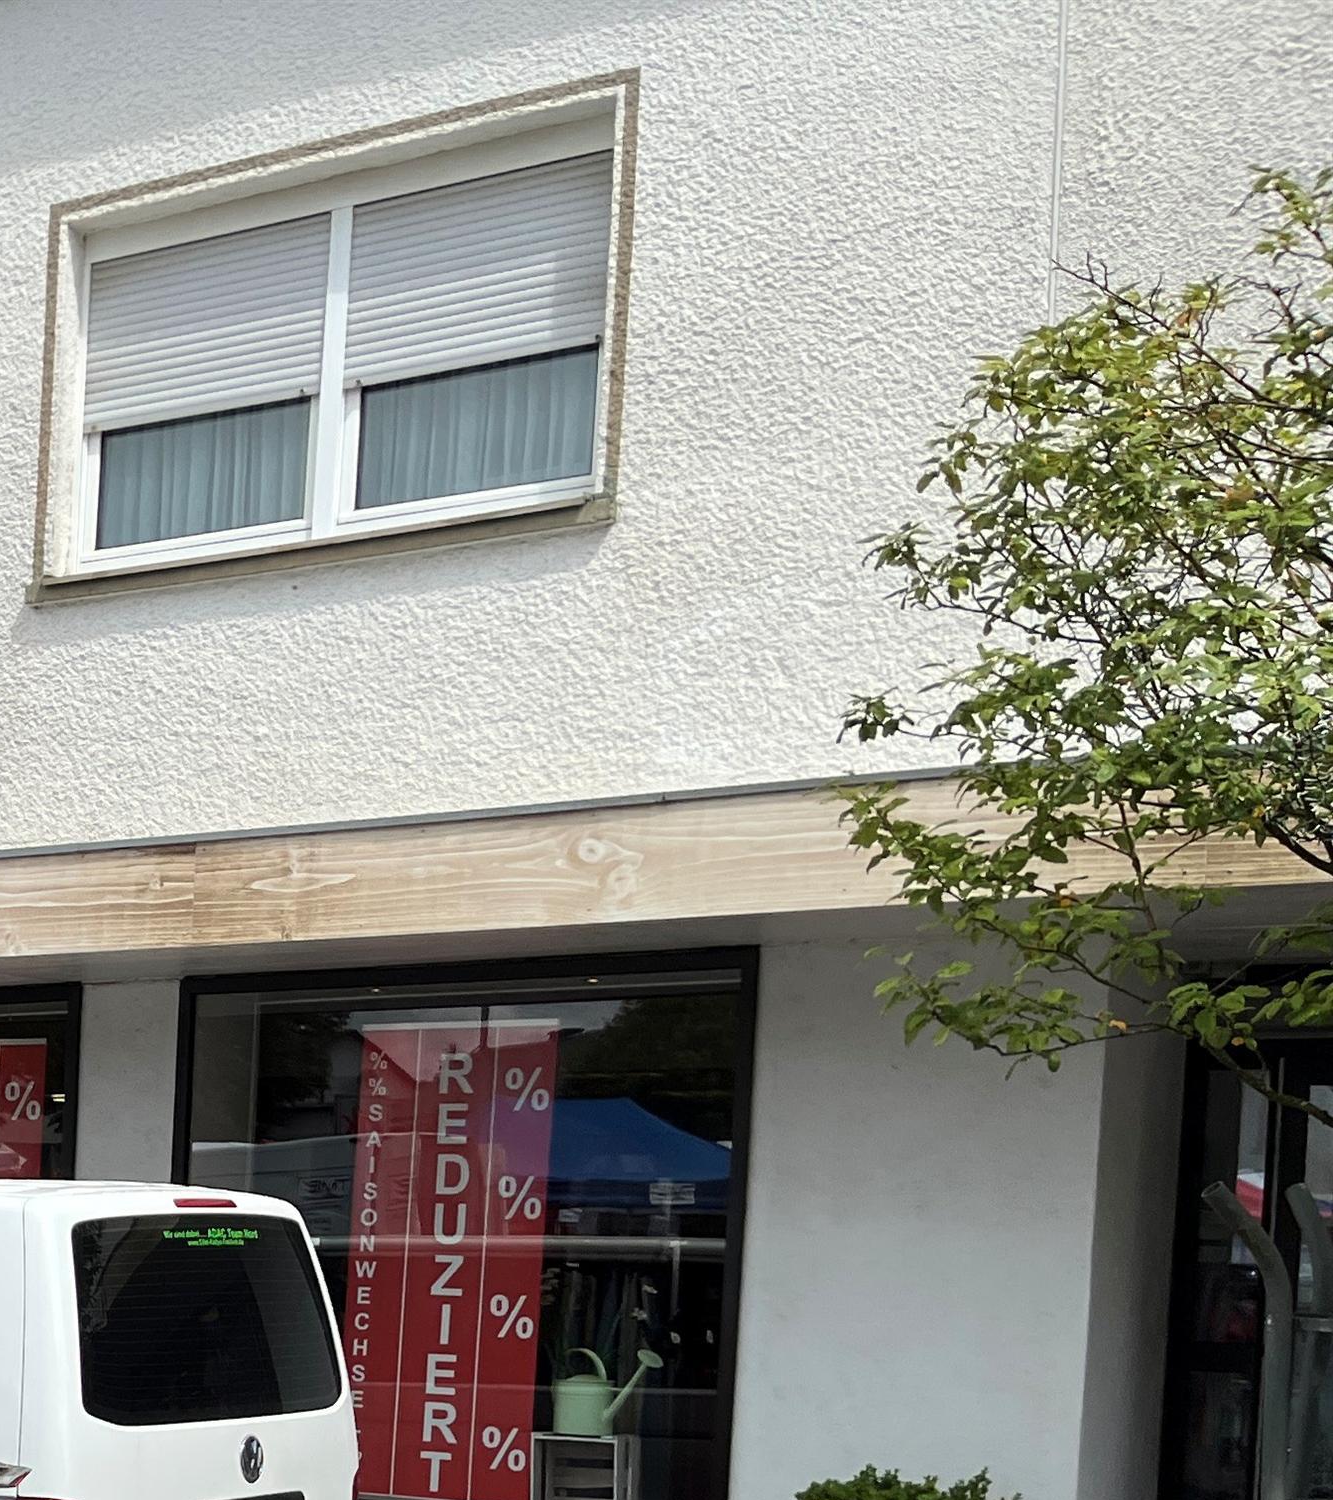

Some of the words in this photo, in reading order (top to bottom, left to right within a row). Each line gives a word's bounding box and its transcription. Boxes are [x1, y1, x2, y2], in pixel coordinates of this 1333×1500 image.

[4, 1081, 41, 1121] %
[505, 1067, 549, 1112] %
[498, 1175, 542, 1220] %
[351, 1104, 384, 1434] SAISONWECHSE
[420, 1053, 474, 1492] REDUZIERT
[490, 1294, 533, 1339] %
[483, 1426, 526, 1472] %
